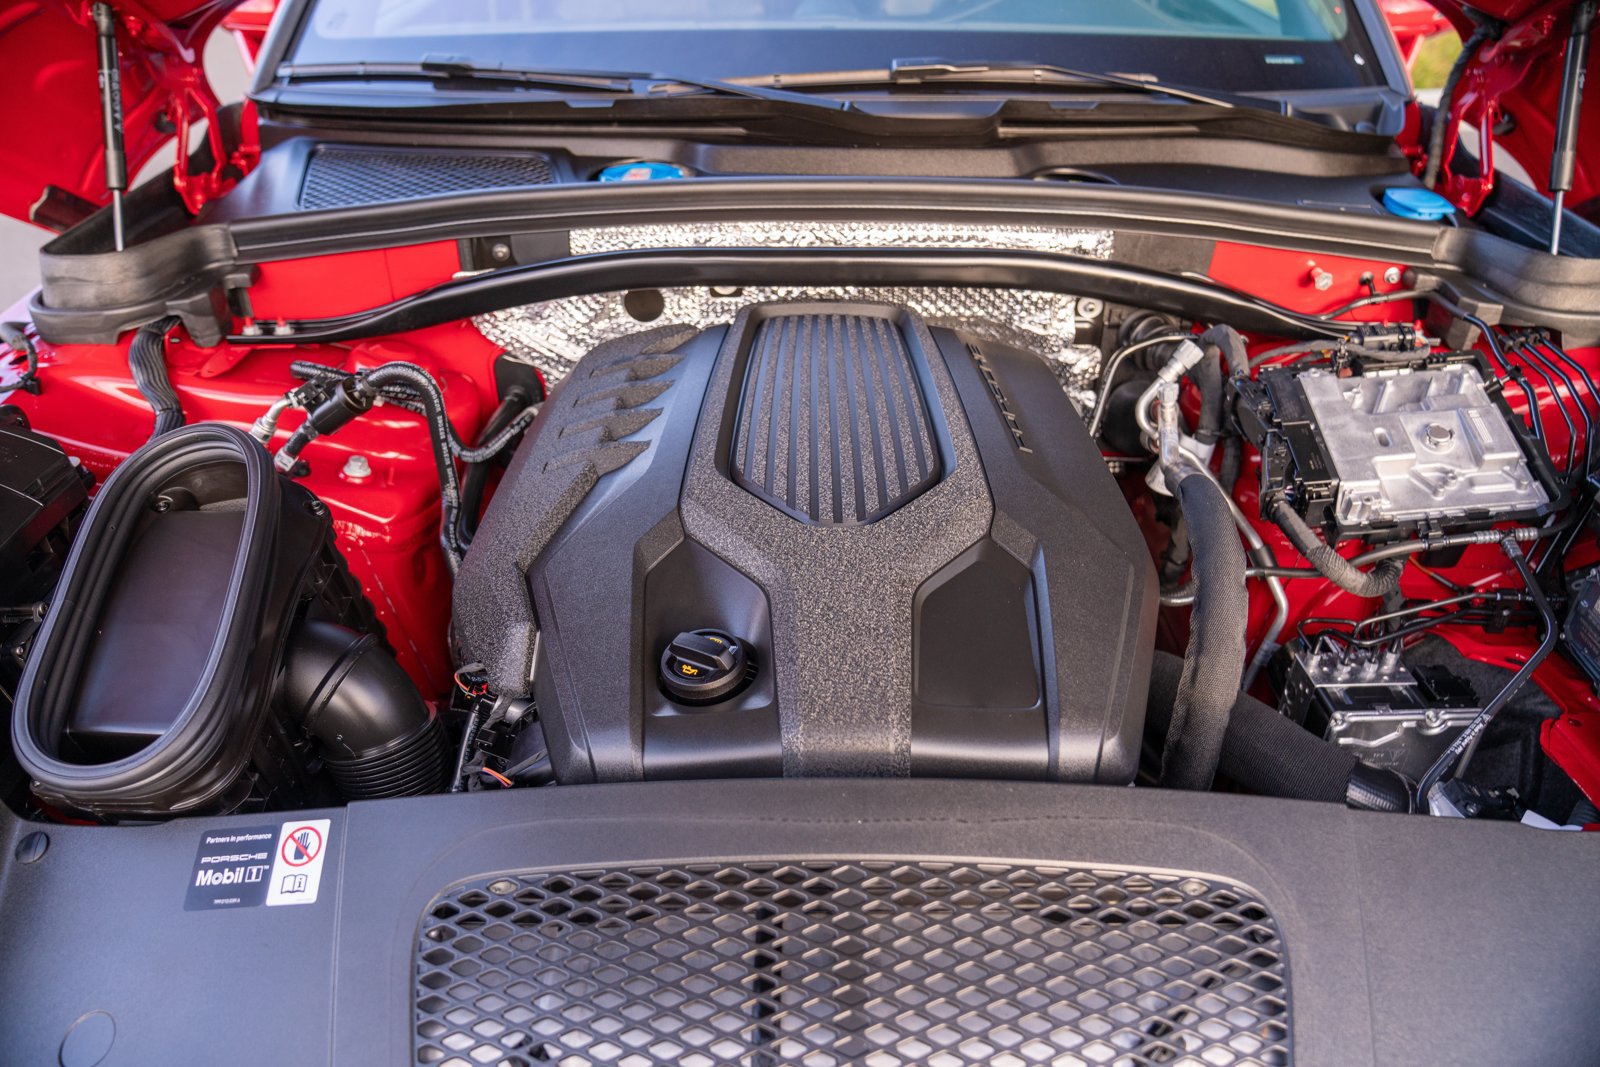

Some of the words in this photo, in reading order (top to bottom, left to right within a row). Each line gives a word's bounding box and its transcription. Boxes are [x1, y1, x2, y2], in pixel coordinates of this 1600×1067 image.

[206, 836, 230, 844] Partners
[236, 833, 272, 843] performance
[201, 852, 268, 864] PORSCHE
[195, 866, 245, 886] Mobil
